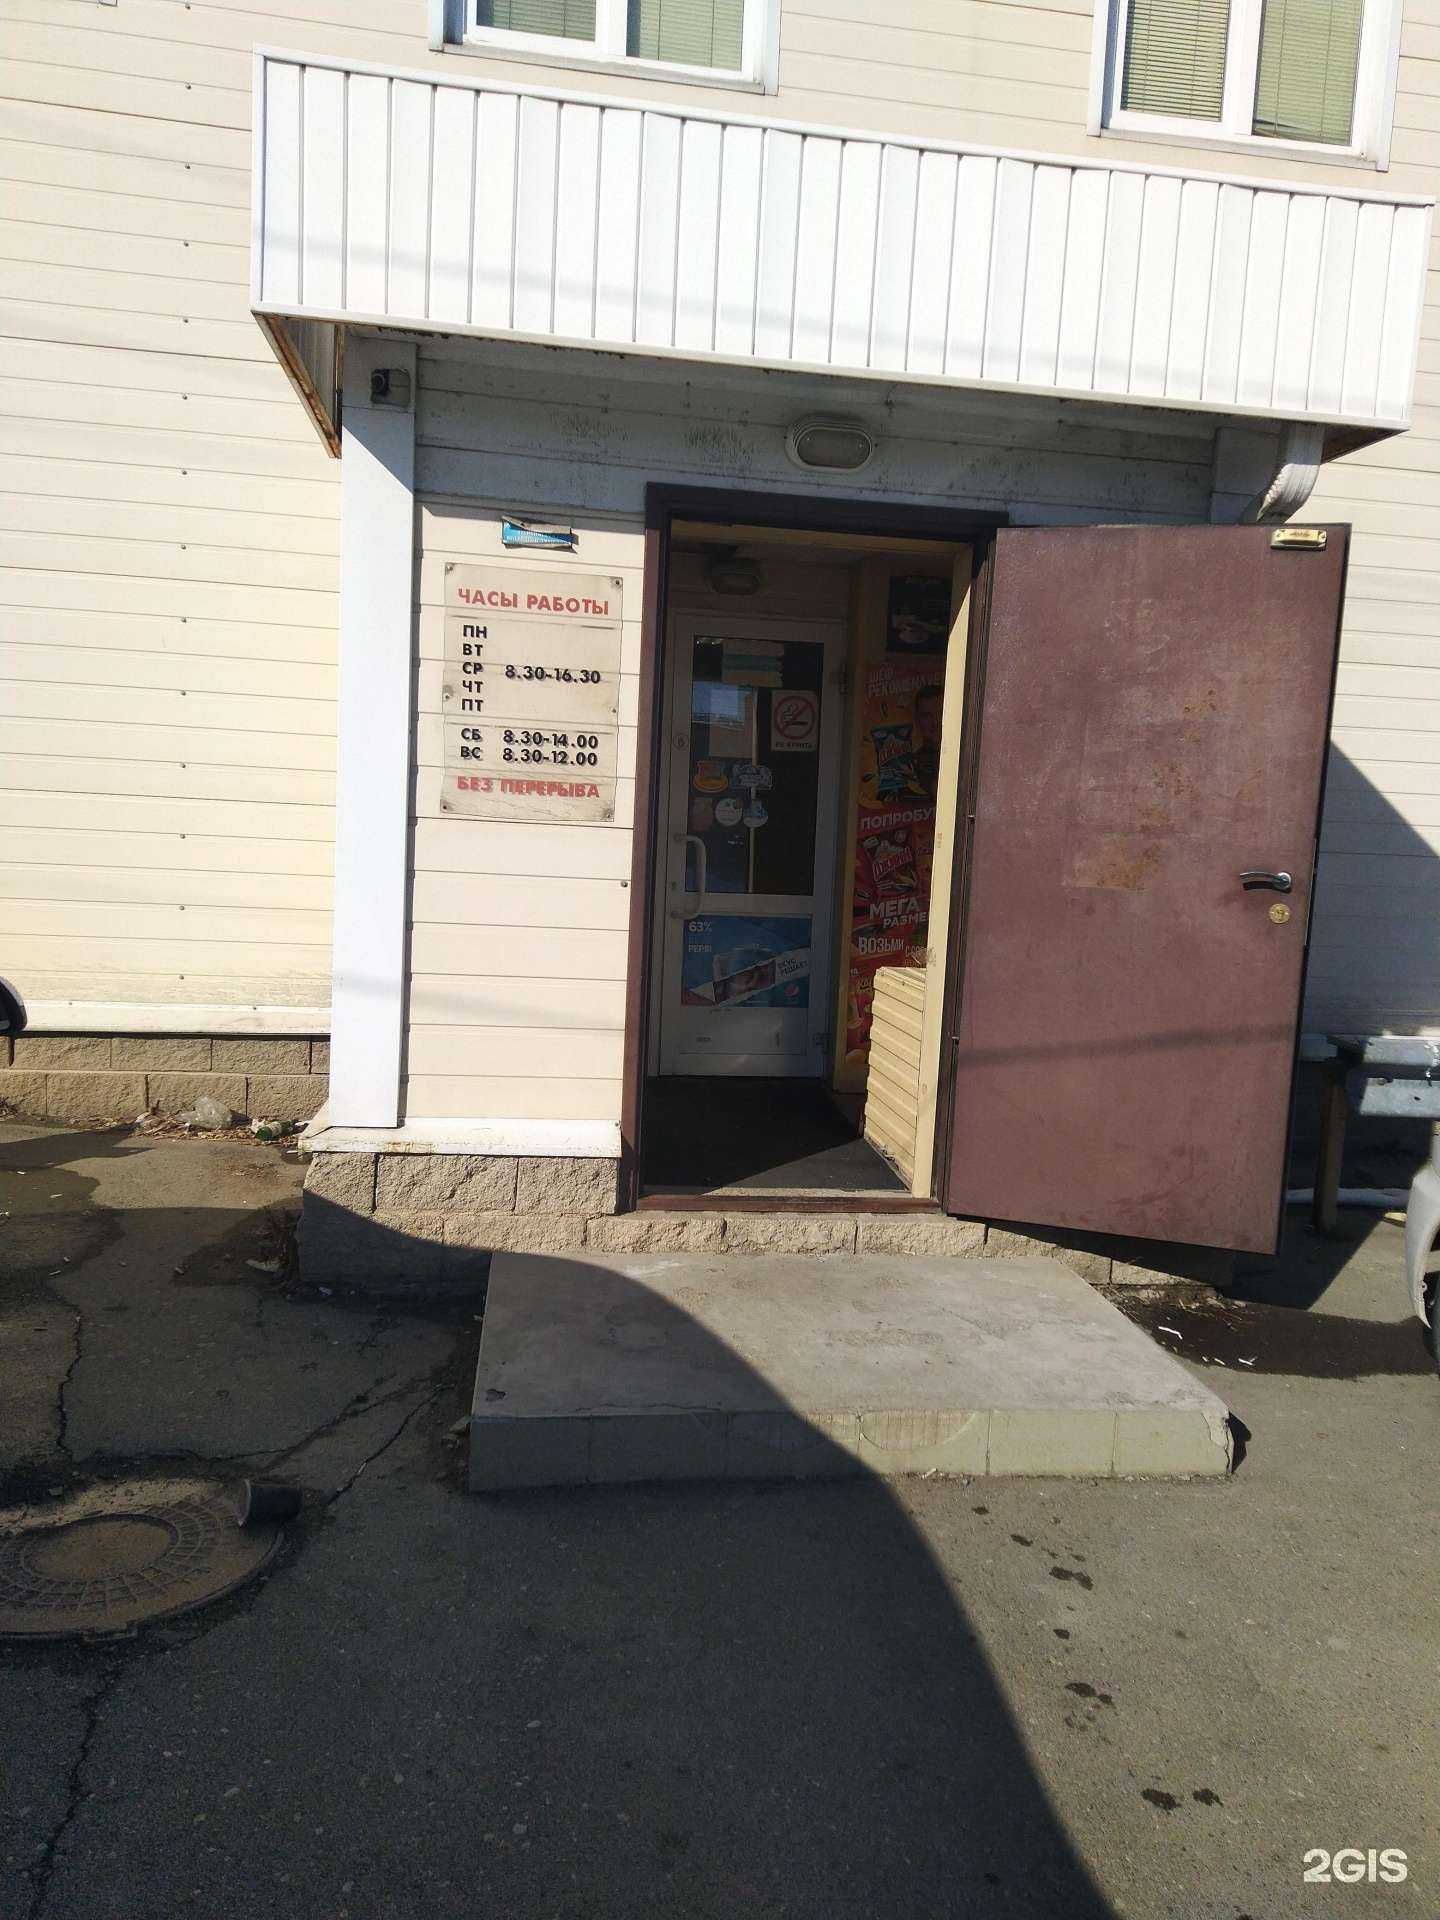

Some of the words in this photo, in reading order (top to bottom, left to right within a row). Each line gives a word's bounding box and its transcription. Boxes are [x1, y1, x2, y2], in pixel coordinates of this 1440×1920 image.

[458, 588, 518, 608] ЧАСЫ
[527, 594, 609, 615] РАБОТЫ
[463, 624, 487, 639] ПН
[462, 643, 483, 656] ВТ
[462, 661, 483, 675] СР
[505, 664, 601, 684] 8.30-16.30
[462, 680, 483, 693] ЧТ
[461, 698, 483, 712] ПТ
[460, 728, 482, 742] СБ
[503, 730, 599, 749] 8.30-14.00
[460, 746, 482, 759] ВС
[502, 747, 598, 766] 8.30-12.00
[457, 776, 493, 791] БЕЗ
[500, 778, 600, 798] ПЕРЕРЫВА
[869, 897, 920, 920] МЕГА
[883, 911, 928, 929] РАЗМЕ
[858, 936, 904, 954] ВОЗЬМИ
